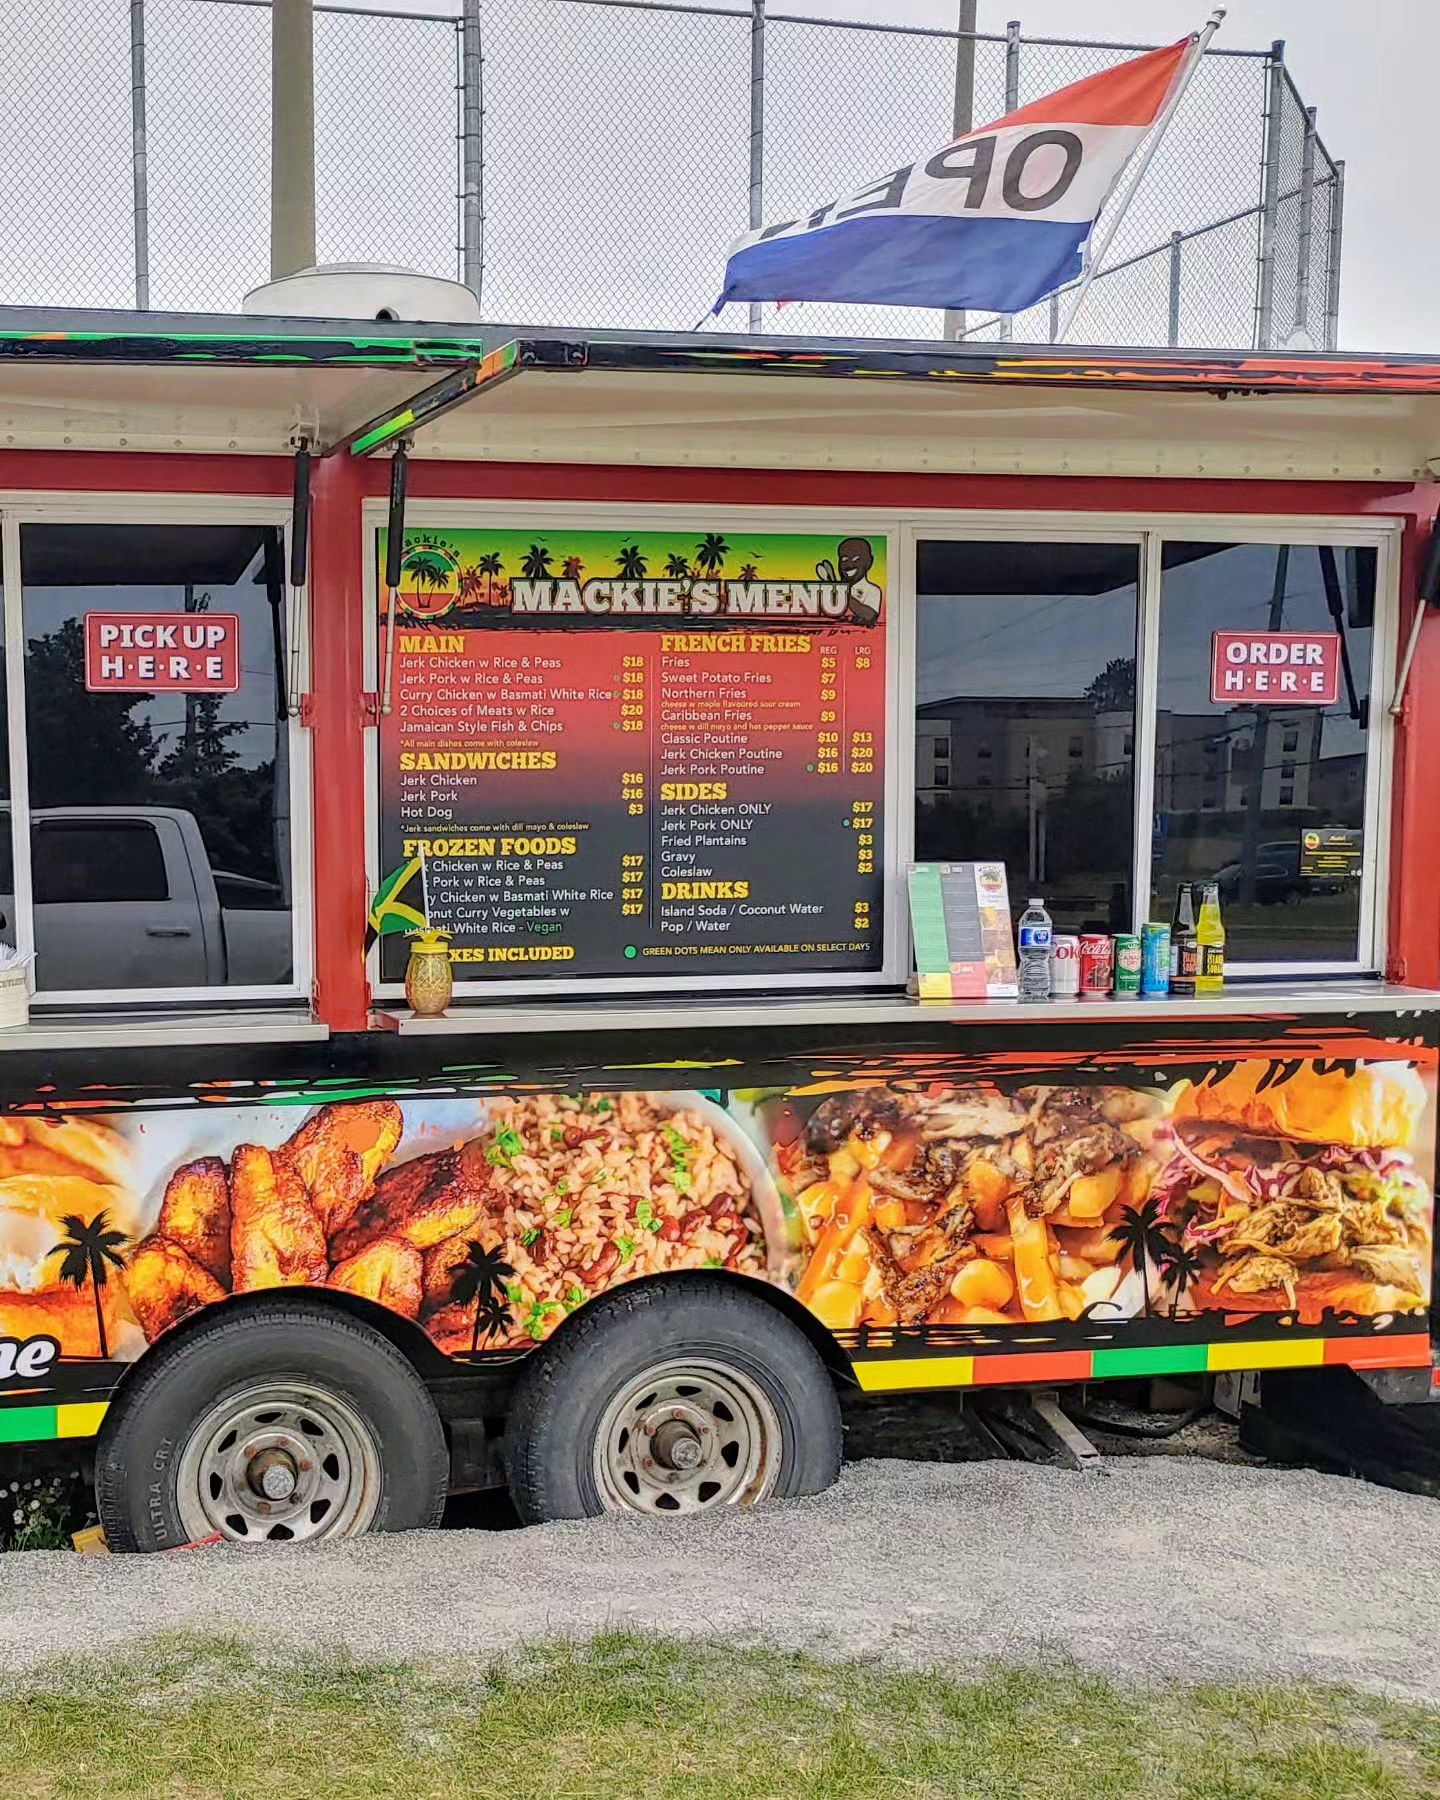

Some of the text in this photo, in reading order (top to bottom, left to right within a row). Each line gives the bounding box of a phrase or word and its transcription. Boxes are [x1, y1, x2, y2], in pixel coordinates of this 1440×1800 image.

[511, 578, 849, 617] MACKIE'S MENU
[101, 625, 225, 648] PICK UP
[400, 636, 464, 653] MAIN
[661, 635, 811, 652] FRENCH FRIES
[1226, 642, 1324, 665] ORDER
[400, 656, 644, 668] Jerk Chicken Rice Peas $18
[662, 657, 870, 668] Fries $5 $8
[400, 673, 644, 684] Jerk Pork Rice Peas $18
[662, 673, 836, 684] Sweet Potato Fries $7
[401, 689, 643, 703] Curry Chicken Basmati White Rice $18
[662, 689, 835, 700] Northern Fries $9
[412, 705, 643, 716] Choices Meats Rice $20
[698, 701, 720, 709] maple
[662, 711, 835, 722] Caribbean Fries $9
[400, 721, 643, 734] Jamaican Style Fish Chips $18
[487, 739, 504, 747] with
[662, 732, 872, 744] Classic Poutine $10 $13
[661, 748, 872, 759] Jerk Chicken Poutine $16 $20
[400, 752, 557, 770] SANDWICHES
[661, 763, 872, 775] Jerk Pork Poutine $16 $20
[401, 774, 643, 786] Jerk Chicken $16
[401, 789, 643, 802] Jerk Pork $16
[661, 783, 727, 800] SIDES
[401, 804, 643, 820] Hot Dog $3
[661, 802, 873, 815] Jerk Chicken ONLY $17
[424, 824, 467, 832] sandwiches
[526, 824, 546, 832] mayo
[661, 818, 873, 831] Jerk Pork ONLY $17
[404, 837, 576, 857] FROZEN FOODS
[662, 835, 872, 846] Fried Plantains $3
[433, 861, 478, 871] Chicken
[496, 861, 520, 870] Rice
[537, 860, 563, 870] Peas
[623, 856, 643, 866] $17
[662, 850, 872, 864] Gravy $3
[662, 863, 872, 877] Coleslaw $2
[433, 877, 459, 887] Pork
[478, 877, 501, 886] Rice
[519, 876, 545, 886] Peas
[623, 872, 643, 883] $17
[440, 893, 485, 902] Chicken
[504, 891, 548, 901] Basmati
[553, 890, 586, 900] White
[591, 890, 613, 899] Rice
[622, 888, 643, 899] $17
[661, 882, 749, 899] DRINKS
[428, 904, 643, 920] onut Curry Vegetables $17
[662, 902, 869, 916] Island Soda Coconut Water $3
[454, 923, 488, 933] White
[492, 922, 515, 932] Rice
[527, 922, 562, 934] Vegan
[662, 918, 869, 934] Pop Water $2
[449, 947, 574, 962] XES INCLUDED
[644, 948, 673, 956] GREEN
[675, 947, 698, 955] DOTS
[700, 946, 727, 954] MEAN
[729, 946, 751, 954] ONLY
[754, 945, 799, 953] AVAILABLE
[801, 944, 815, 952] ON
[817, 943, 846, 951] SELECT
[149, 1483, 168, 1541] ULTRA
